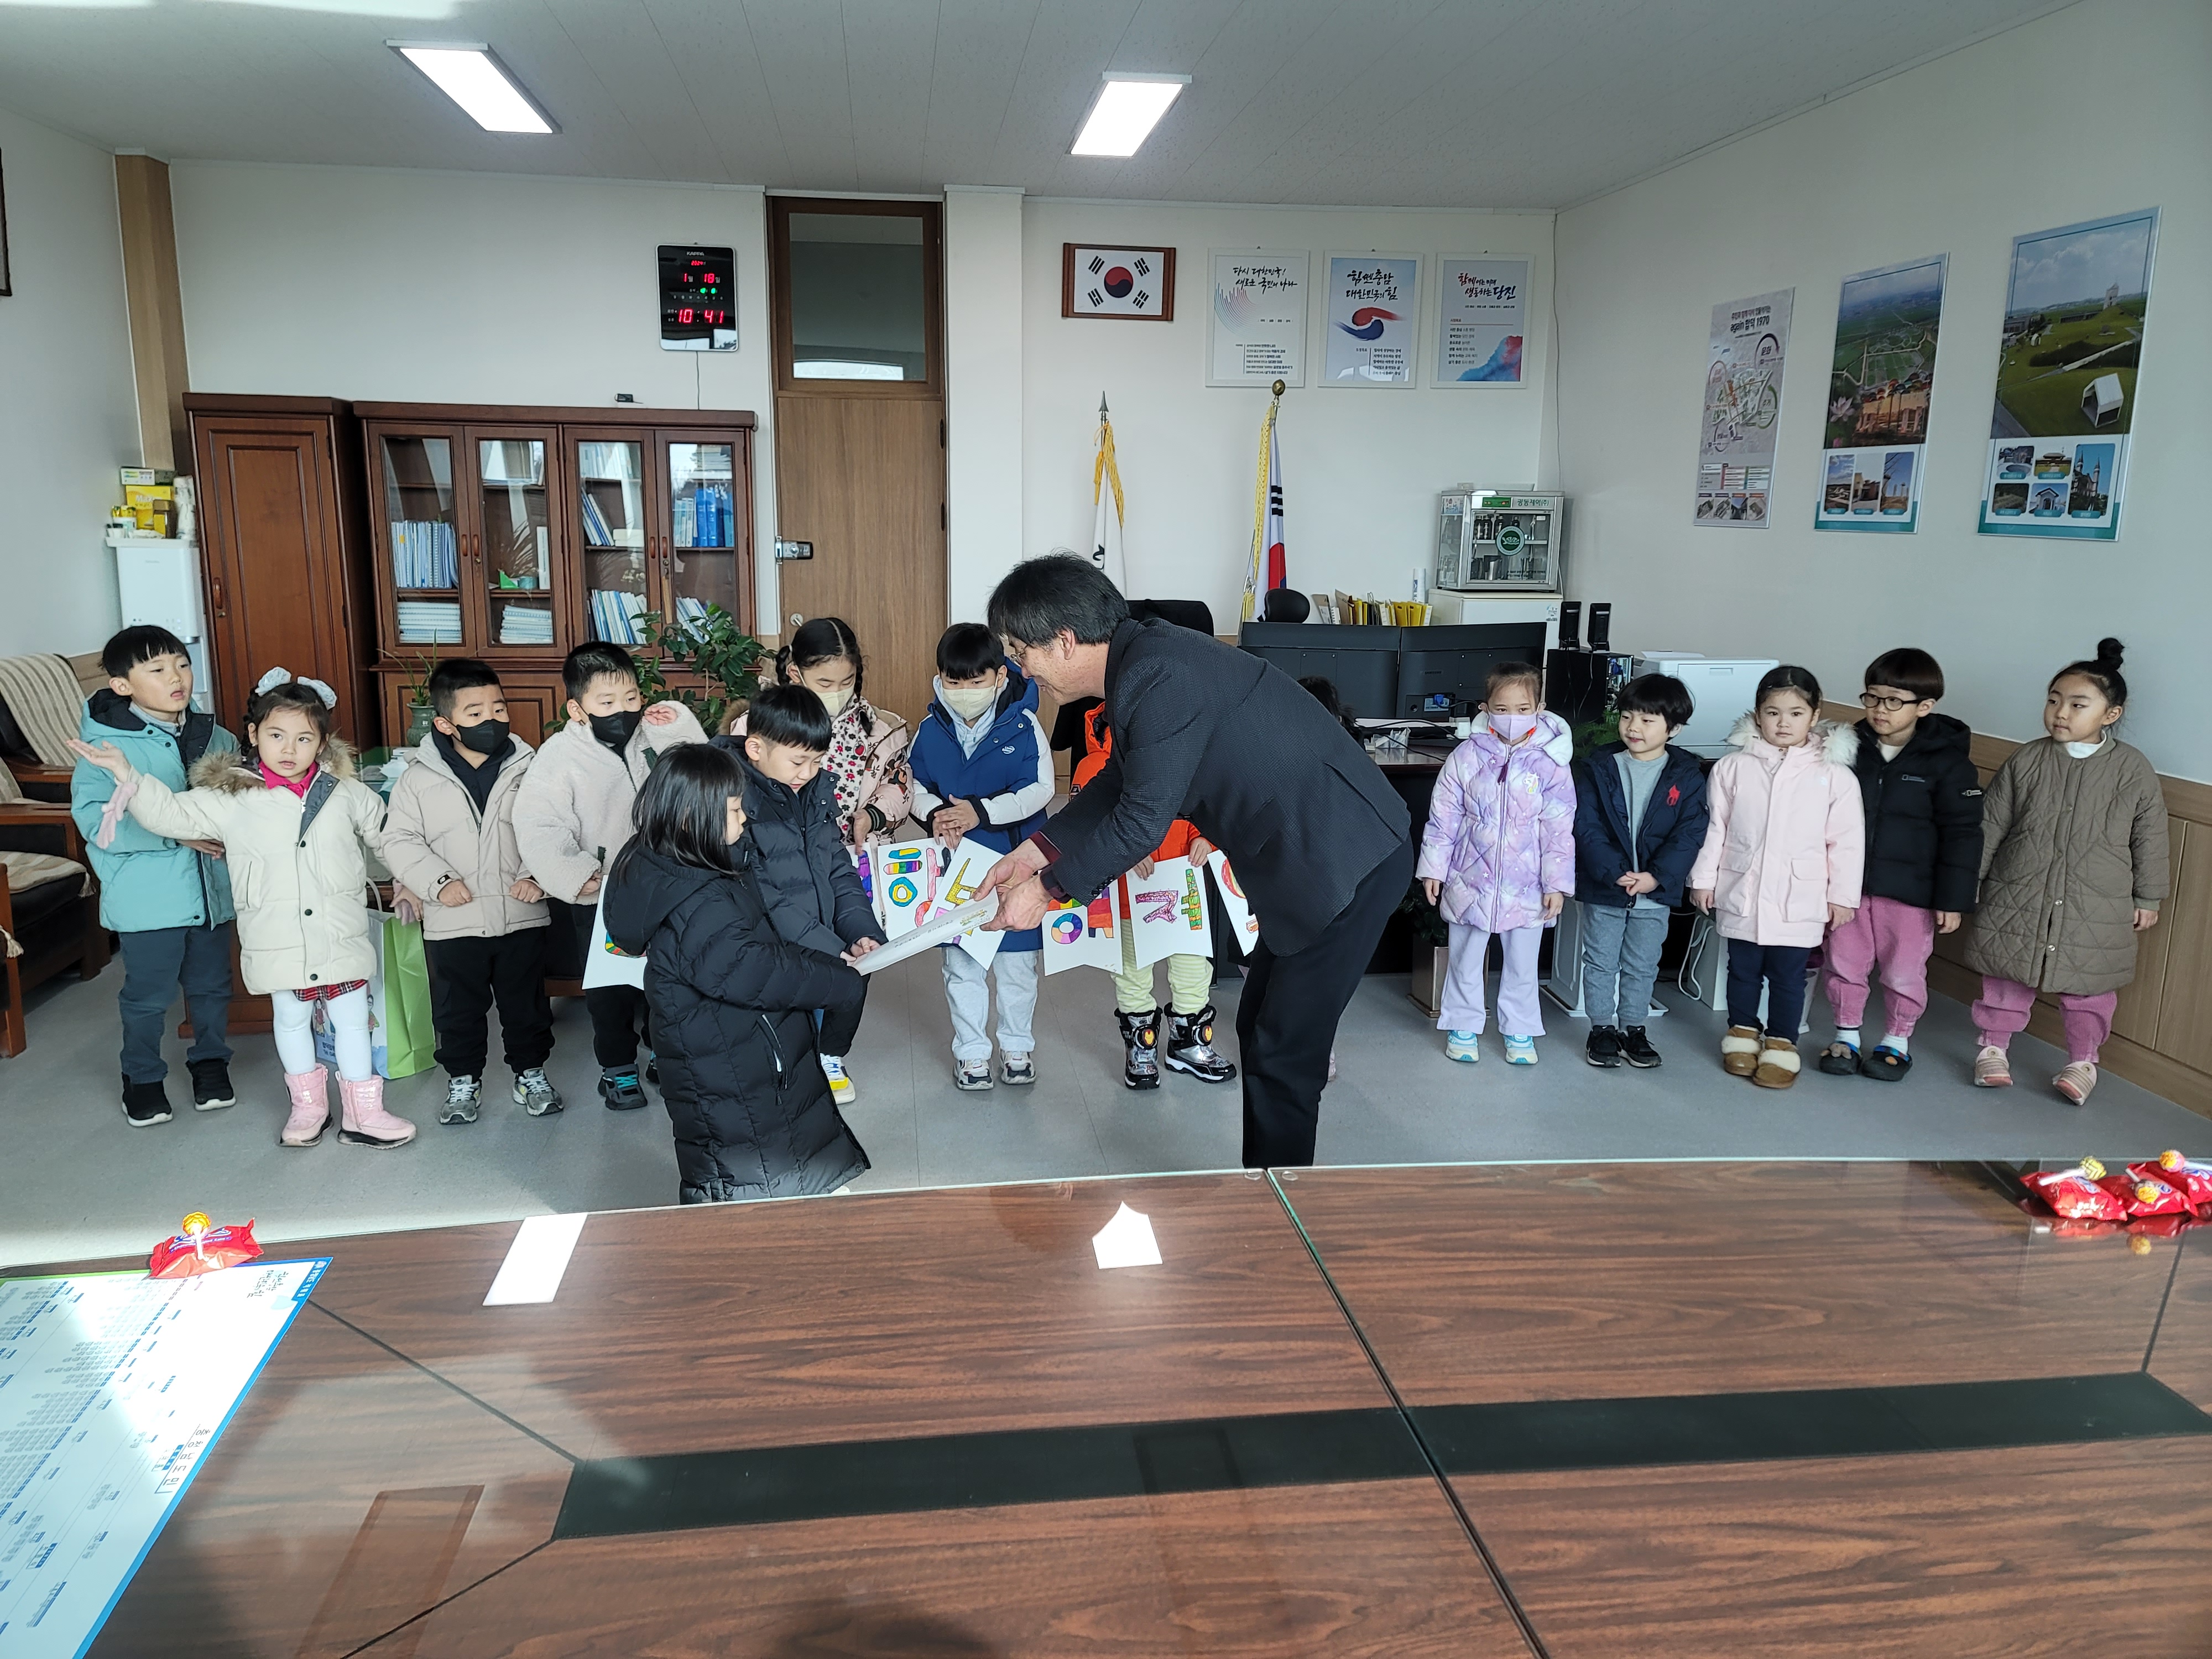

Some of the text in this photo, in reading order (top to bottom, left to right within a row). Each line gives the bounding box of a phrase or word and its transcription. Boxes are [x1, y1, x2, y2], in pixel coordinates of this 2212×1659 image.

[1233, 265, 1286, 278] 다시 대한민국!
[1235, 277, 1298, 295] 새로운 국민의 나라
[1465, 285, 1516, 300] 생동하는 당진
[1346, 286, 1398, 302] 대한민국의 힘
[1756, 315, 1770, 327] 1970
